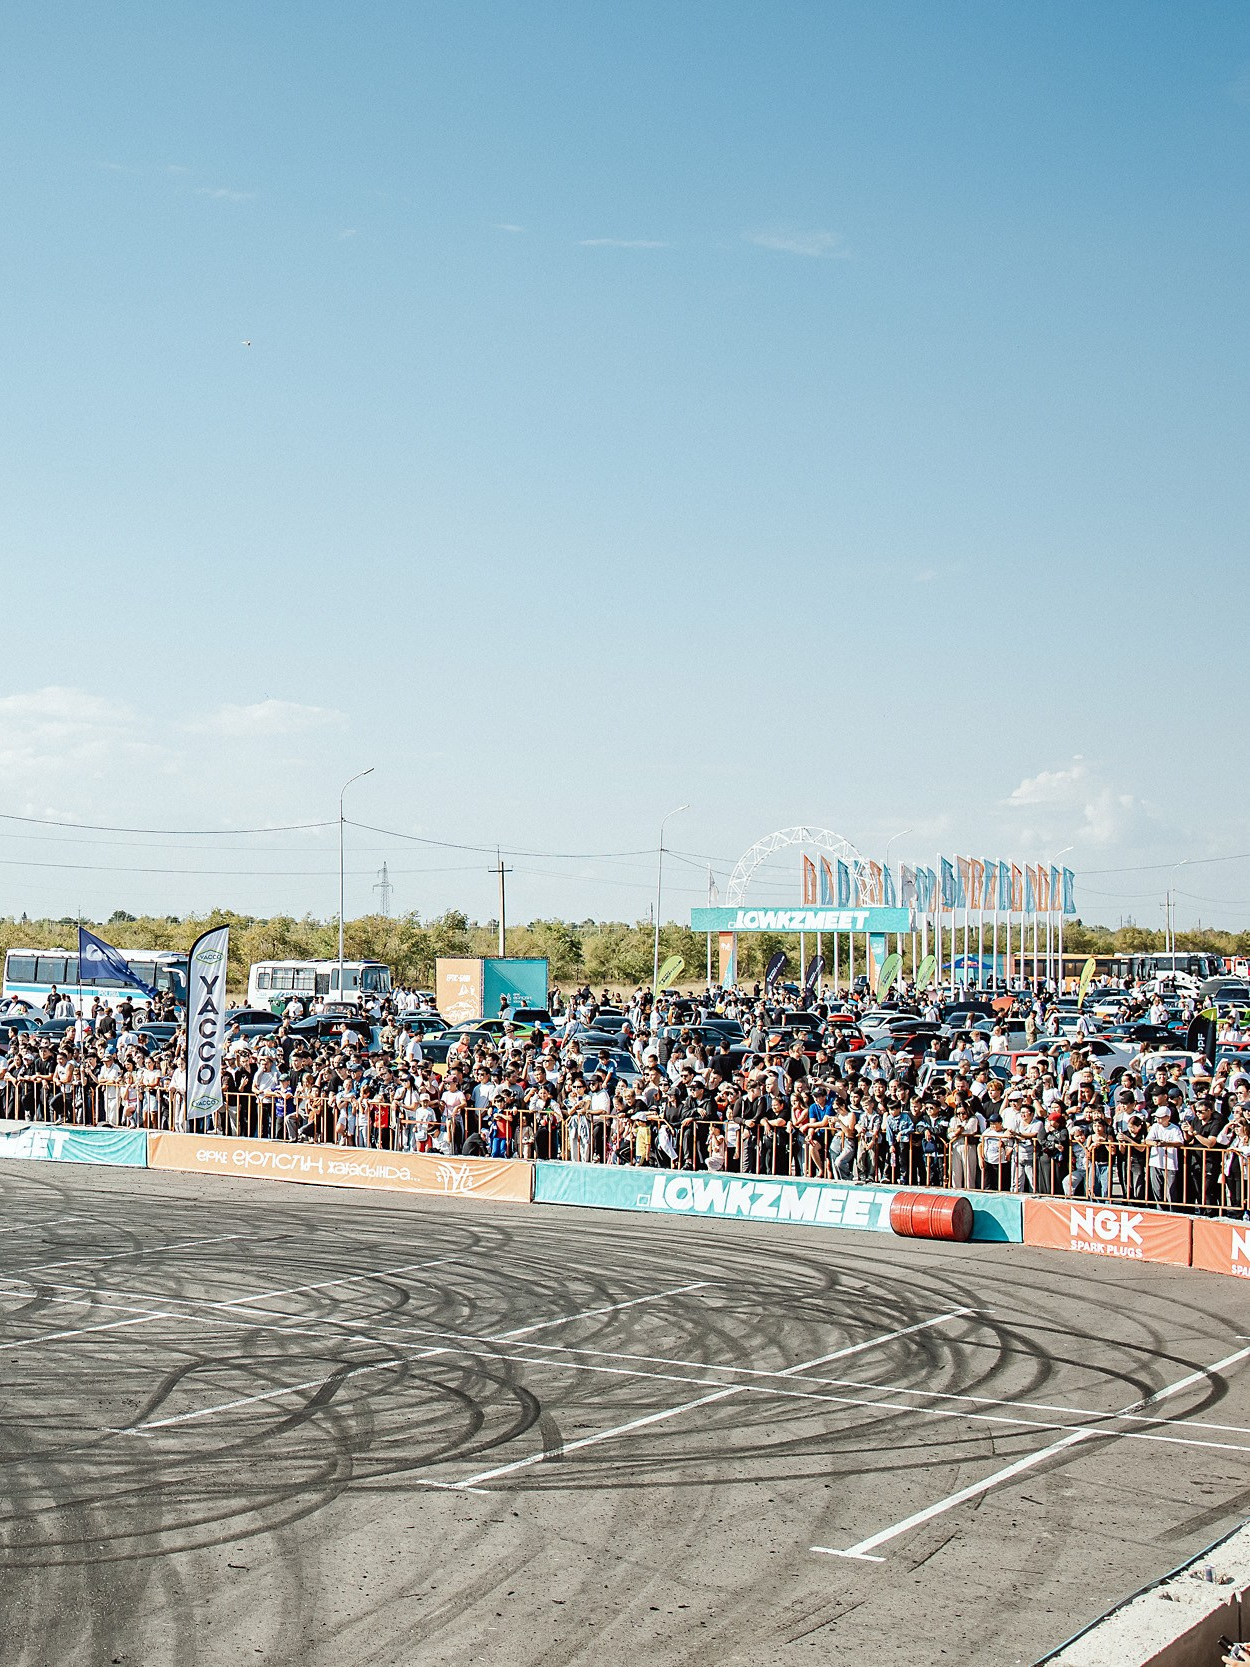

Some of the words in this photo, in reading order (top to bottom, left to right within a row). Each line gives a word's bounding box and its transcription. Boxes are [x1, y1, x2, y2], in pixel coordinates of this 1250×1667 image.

[735, 910, 870, 929] LOWKZMEET
[197, 975, 220, 1085] YACCO
[1070, 1206, 1144, 1245] NGK
[1070, 1240, 1106, 1254] SPARK
[1107, 1244, 1144, 1258] PLUGS
